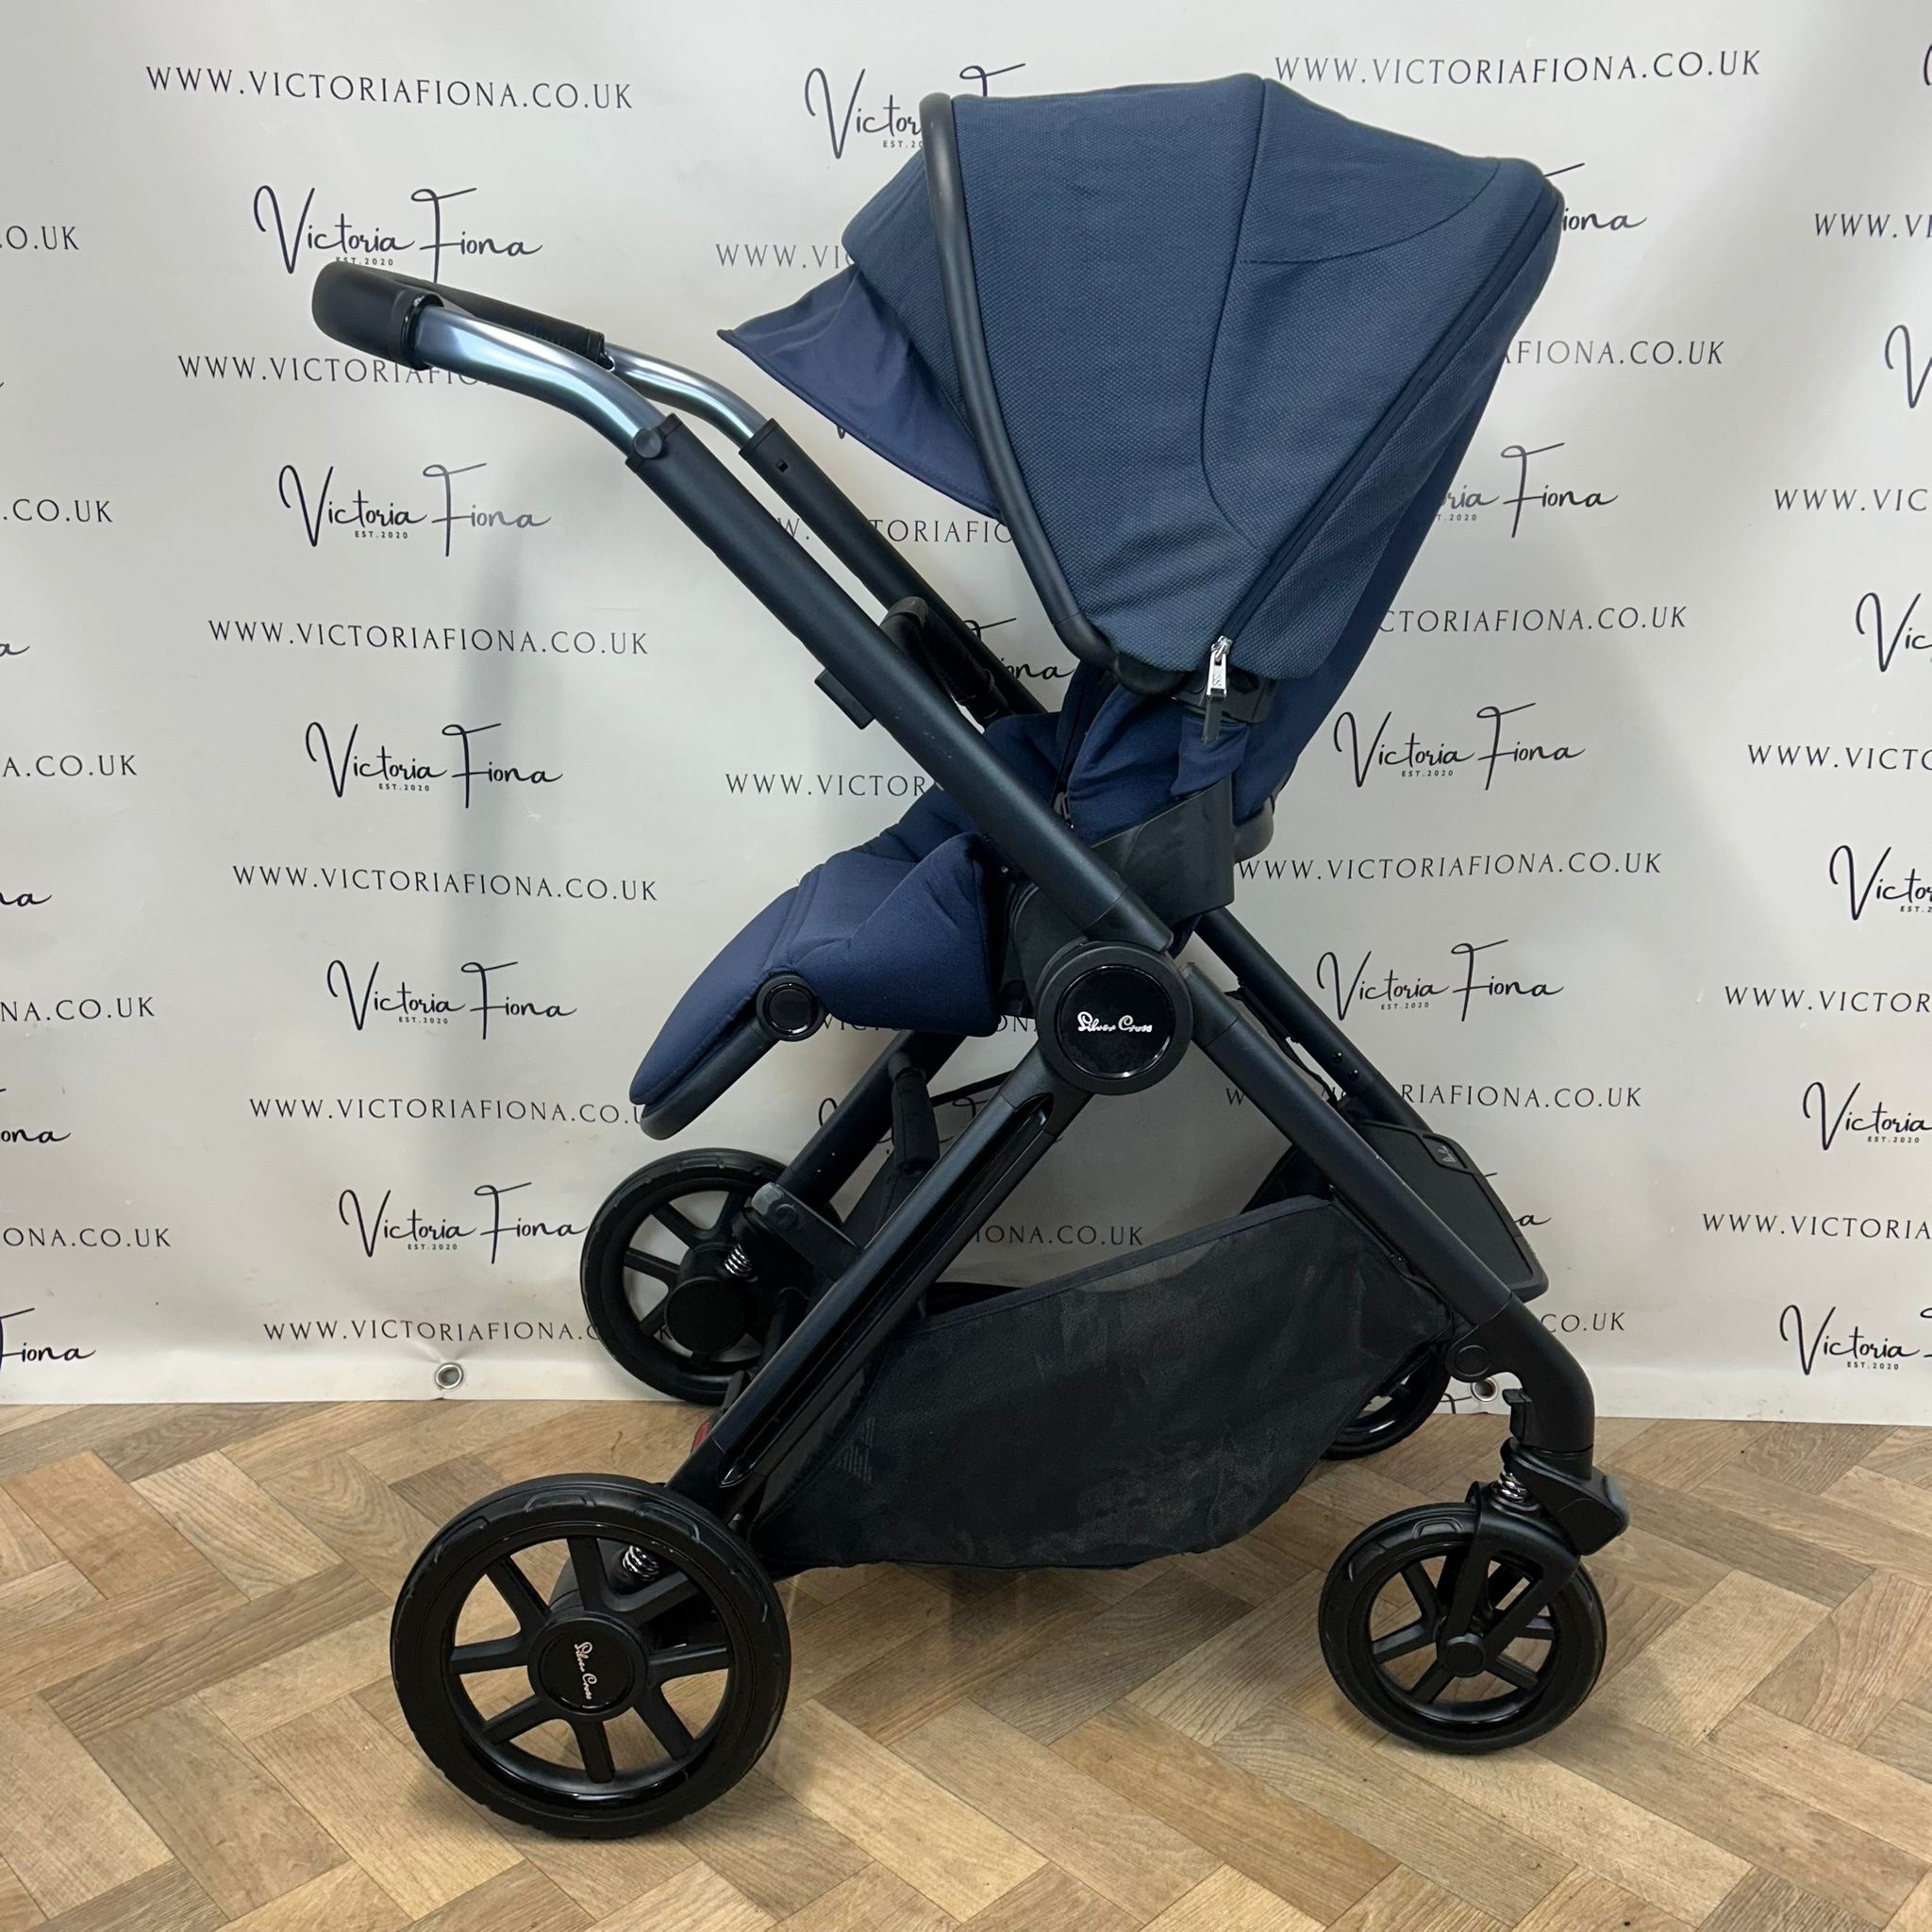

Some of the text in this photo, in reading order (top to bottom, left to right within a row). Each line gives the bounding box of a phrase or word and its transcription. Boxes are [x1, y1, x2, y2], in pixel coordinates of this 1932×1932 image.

[1275, 50, 1760, 84] WWW.VICTORIAFIONA.CO.UK
[145, 66, 632, 108] WWW.VICTORIAFIONA.CO.UK
[805, 68, 922, 159] Victor
[0, 225, 79, 250] O.UK
[254, 185, 542, 283] Victoria Fiona
[1501, 442, 1619, 539] Fiona
[1774, 489, 1927, 511] WWW.VIC
[278, 463, 551, 558] Victoria Fiona
[355, 530, 408, 539] EST.2020
[208, 620, 648, 655] WWW.VICTORIAFIONA.CO.UK
[1333, 703, 1585, 791] Victoria Fiona
[2, 755, 137, 777] A.CO.UK
[306, 722, 563, 808] Victoria Fiona
[378, 783, 429, 791] EST.2020
[725, 774, 926, 796] WWW.VICTOR
[1239, 852, 1662, 879] WWW.VICTORIAFIONA.CO.UK
[232, 865, 657, 901] WWW.VICTORIAFIONA.CO.UK
[1316, 940, 1564, 1022] Victoria Fiona
[0, 997, 155, 1022] NA.CO.UK
[326, 959, 577, 1041] Victoria Fiona
[1381, 1002, 1429, 1010] EST.2020
[1724, 986, 1930, 1012] WWW.VICTOR
[399, 1016, 448, 1024] EST.2020
[1803, 1081, 1932, 1151] Victoria
[3, 1227, 171, 1247] ONA.CO.UK
[339, 1182, 588, 1264] Victoria Fiona
[1703, 1213, 1931, 1240] WWW.VICTORIA
[1779, 1305, 1922, 1375] Victoria
[1847, 1361, 1899, 1370] EST.2020
